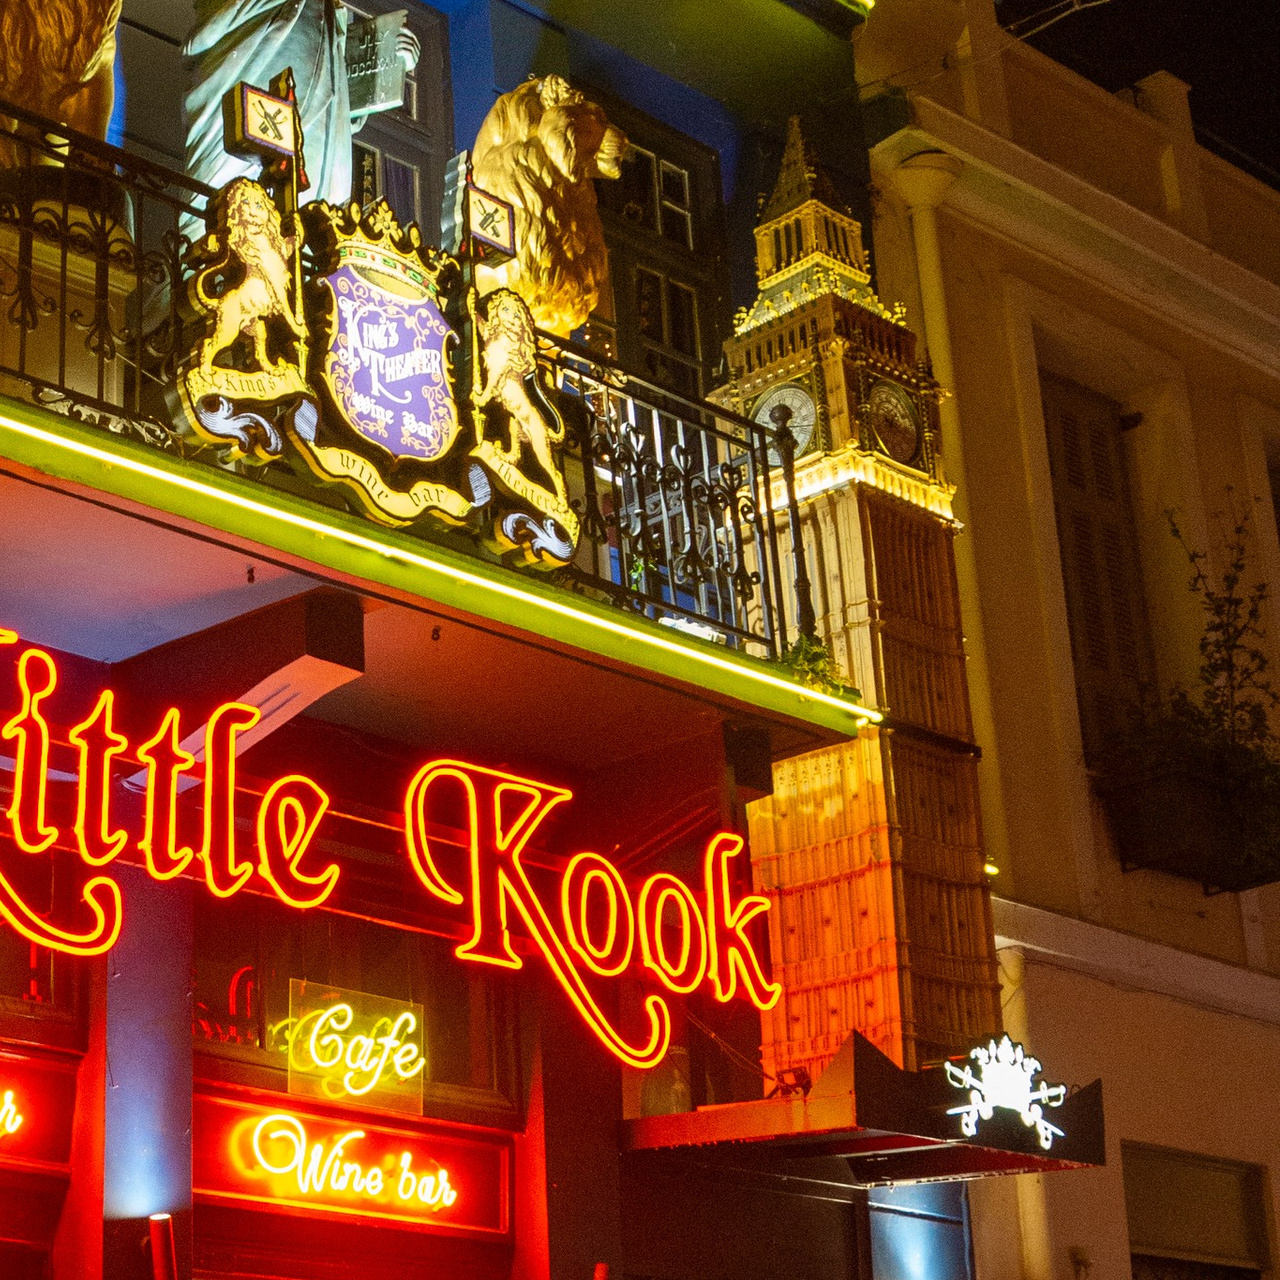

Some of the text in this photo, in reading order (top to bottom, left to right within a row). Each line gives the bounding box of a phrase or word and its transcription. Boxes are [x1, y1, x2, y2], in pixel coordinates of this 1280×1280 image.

[338, 296, 400, 371] KING'S
[224, 372, 276, 398] King's
[364, 347, 441, 404] THEATER
[351, 392, 435, 439] Wine Bar
[339, 452, 445, 507] wine bar
[405, 758, 782, 1070] Kook
[308, 1003, 426, 1096] Cafe
[252, 1114, 458, 1207] Wine bar
